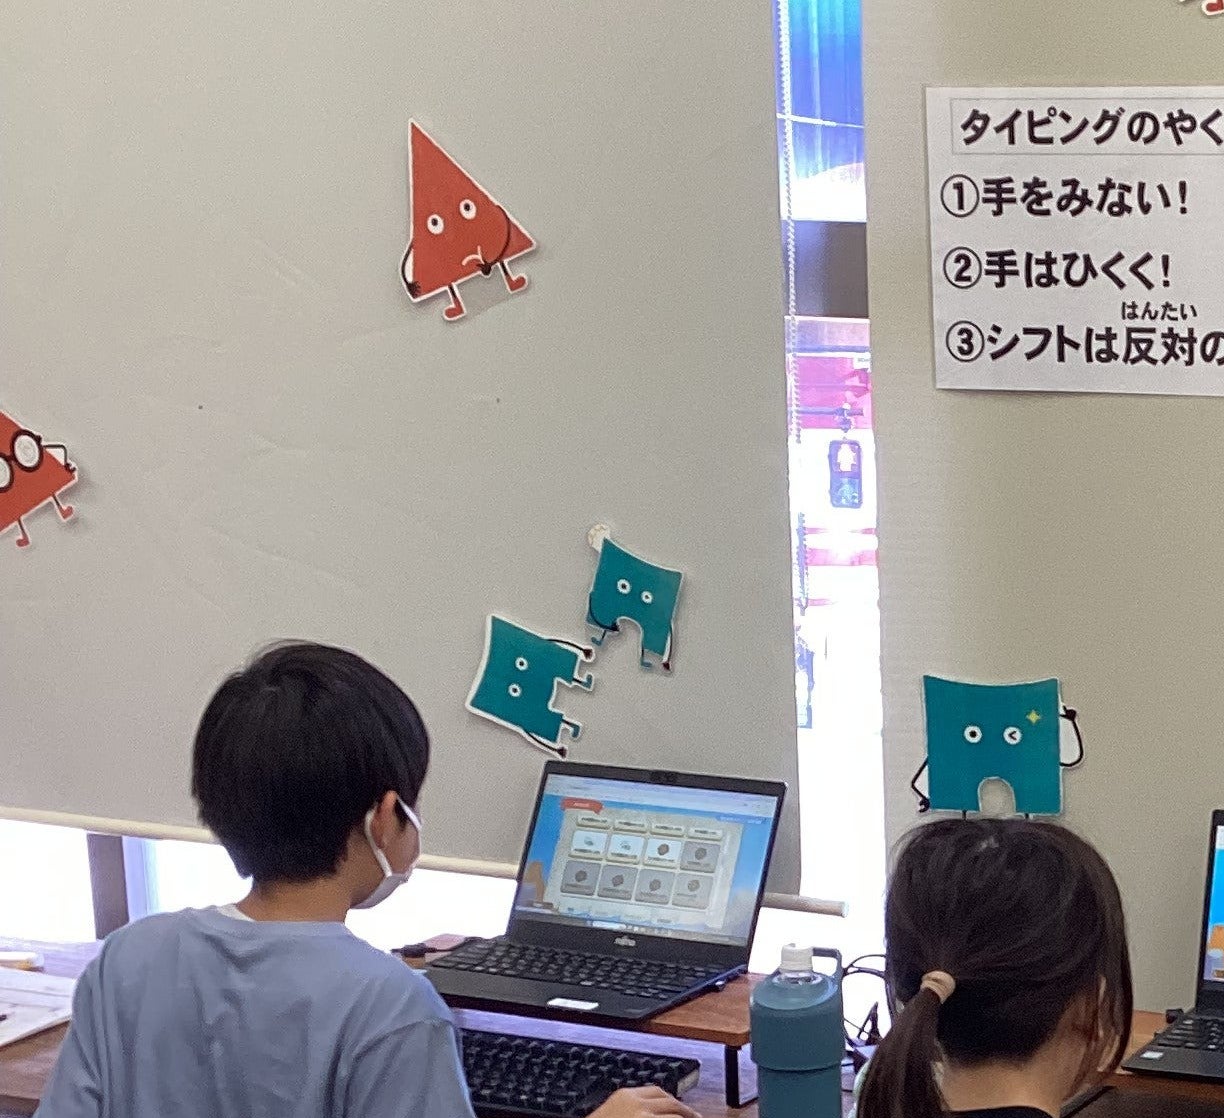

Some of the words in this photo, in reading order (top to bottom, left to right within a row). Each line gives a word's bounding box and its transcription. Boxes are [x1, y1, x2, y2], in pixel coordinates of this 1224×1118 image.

[940, 173, 1188, 218] ①手をみない！
[942, 246, 1171, 290] ②手はひくく！
[1121, 301, 1198, 321] はんたい
